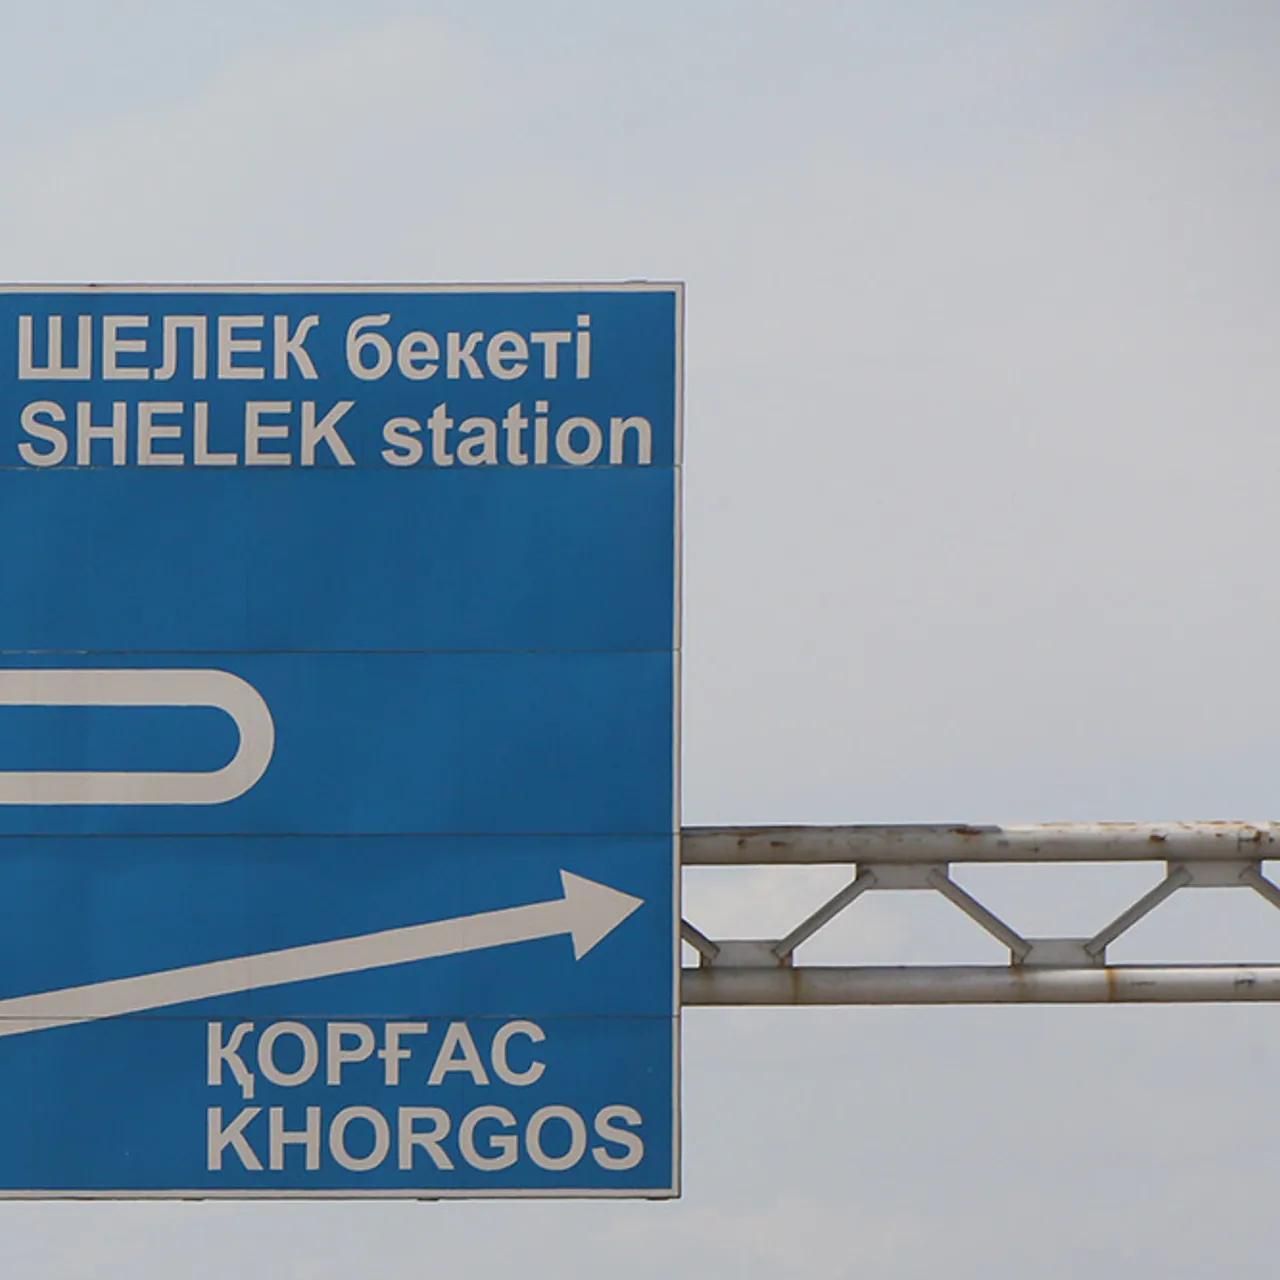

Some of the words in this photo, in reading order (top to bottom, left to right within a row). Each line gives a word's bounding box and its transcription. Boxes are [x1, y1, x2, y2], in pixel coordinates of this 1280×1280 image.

[18, 314, 320, 381] ШЕЛЕК
[346, 313, 591, 381] бекеті
[17, 400, 356, 467] SHELEK
[381, 400, 652, 467] station
[207, 1020, 546, 1099] ҚОРҒАС
[207, 1104, 645, 1172] KHORGOS
